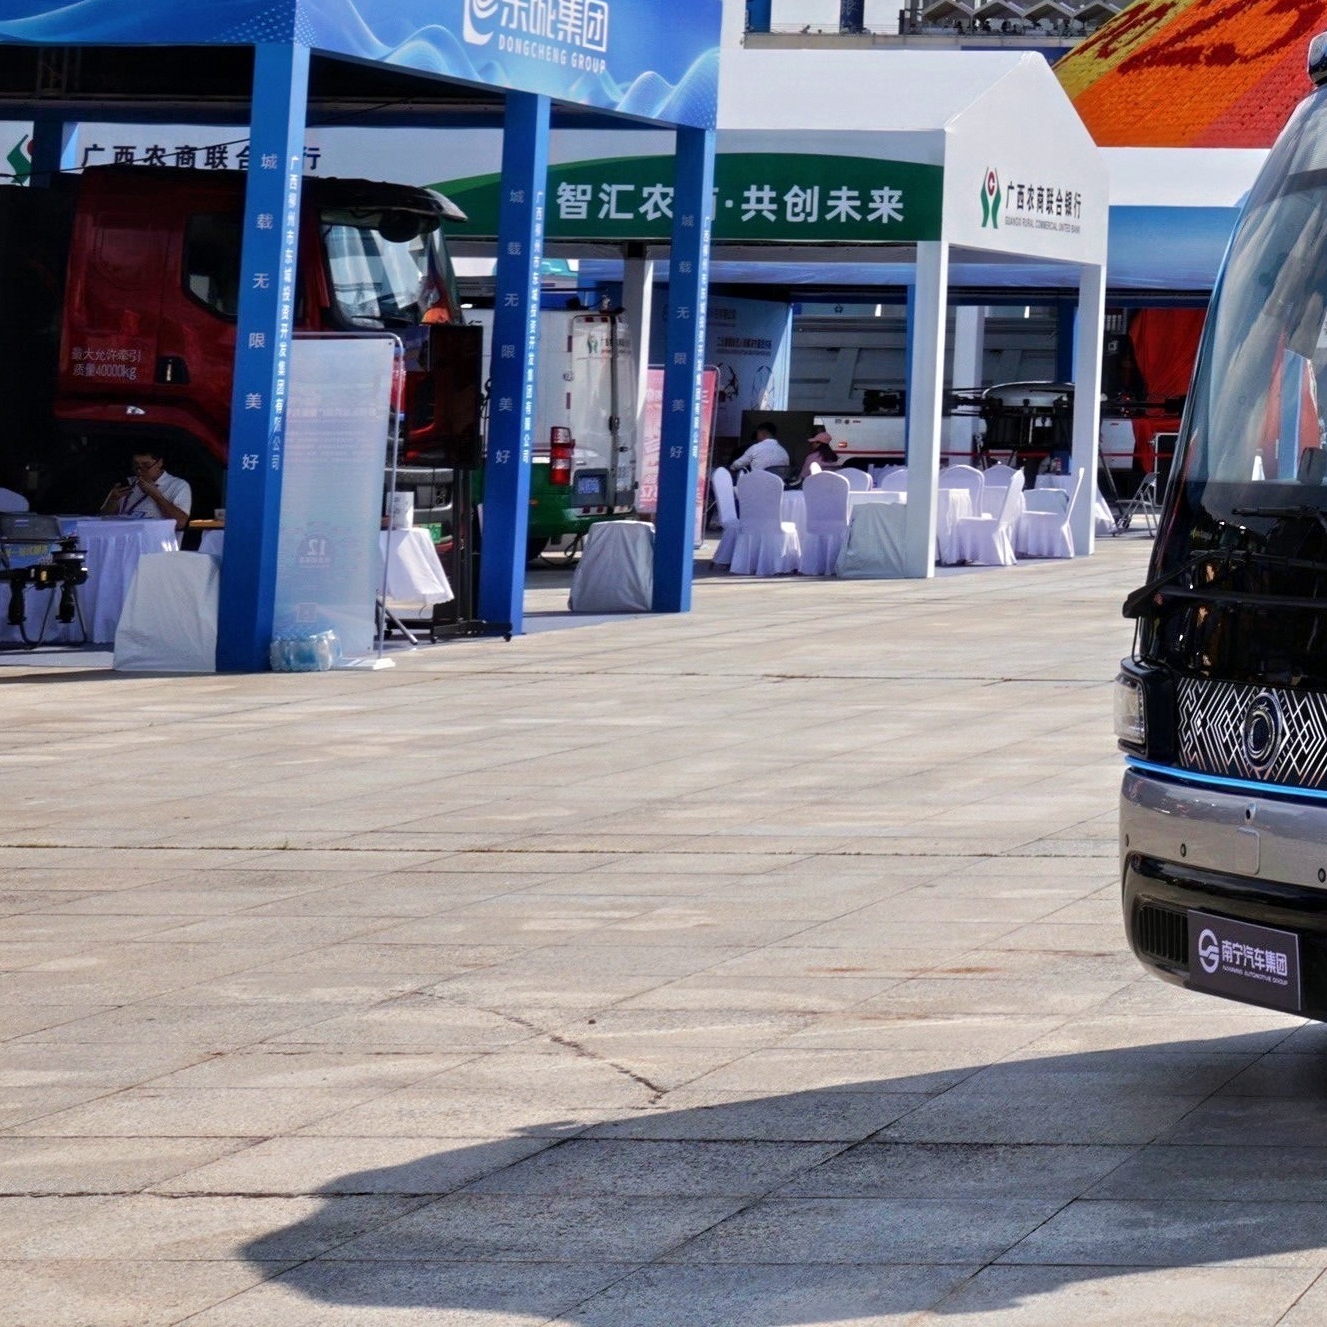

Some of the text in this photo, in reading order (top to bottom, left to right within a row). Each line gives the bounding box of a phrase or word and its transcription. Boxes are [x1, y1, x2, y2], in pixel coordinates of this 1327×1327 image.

[499, 34, 606, 73] DONGCHENG GROUP
[82, 143, 321, 171] 广西农商联合行
[556, 181, 904, 223] 智汇农·共创未来
[1005, 181, 1081, 219] 广西农商联合银行
[1222, 939, 1288, 976] 南宁汽车集团
